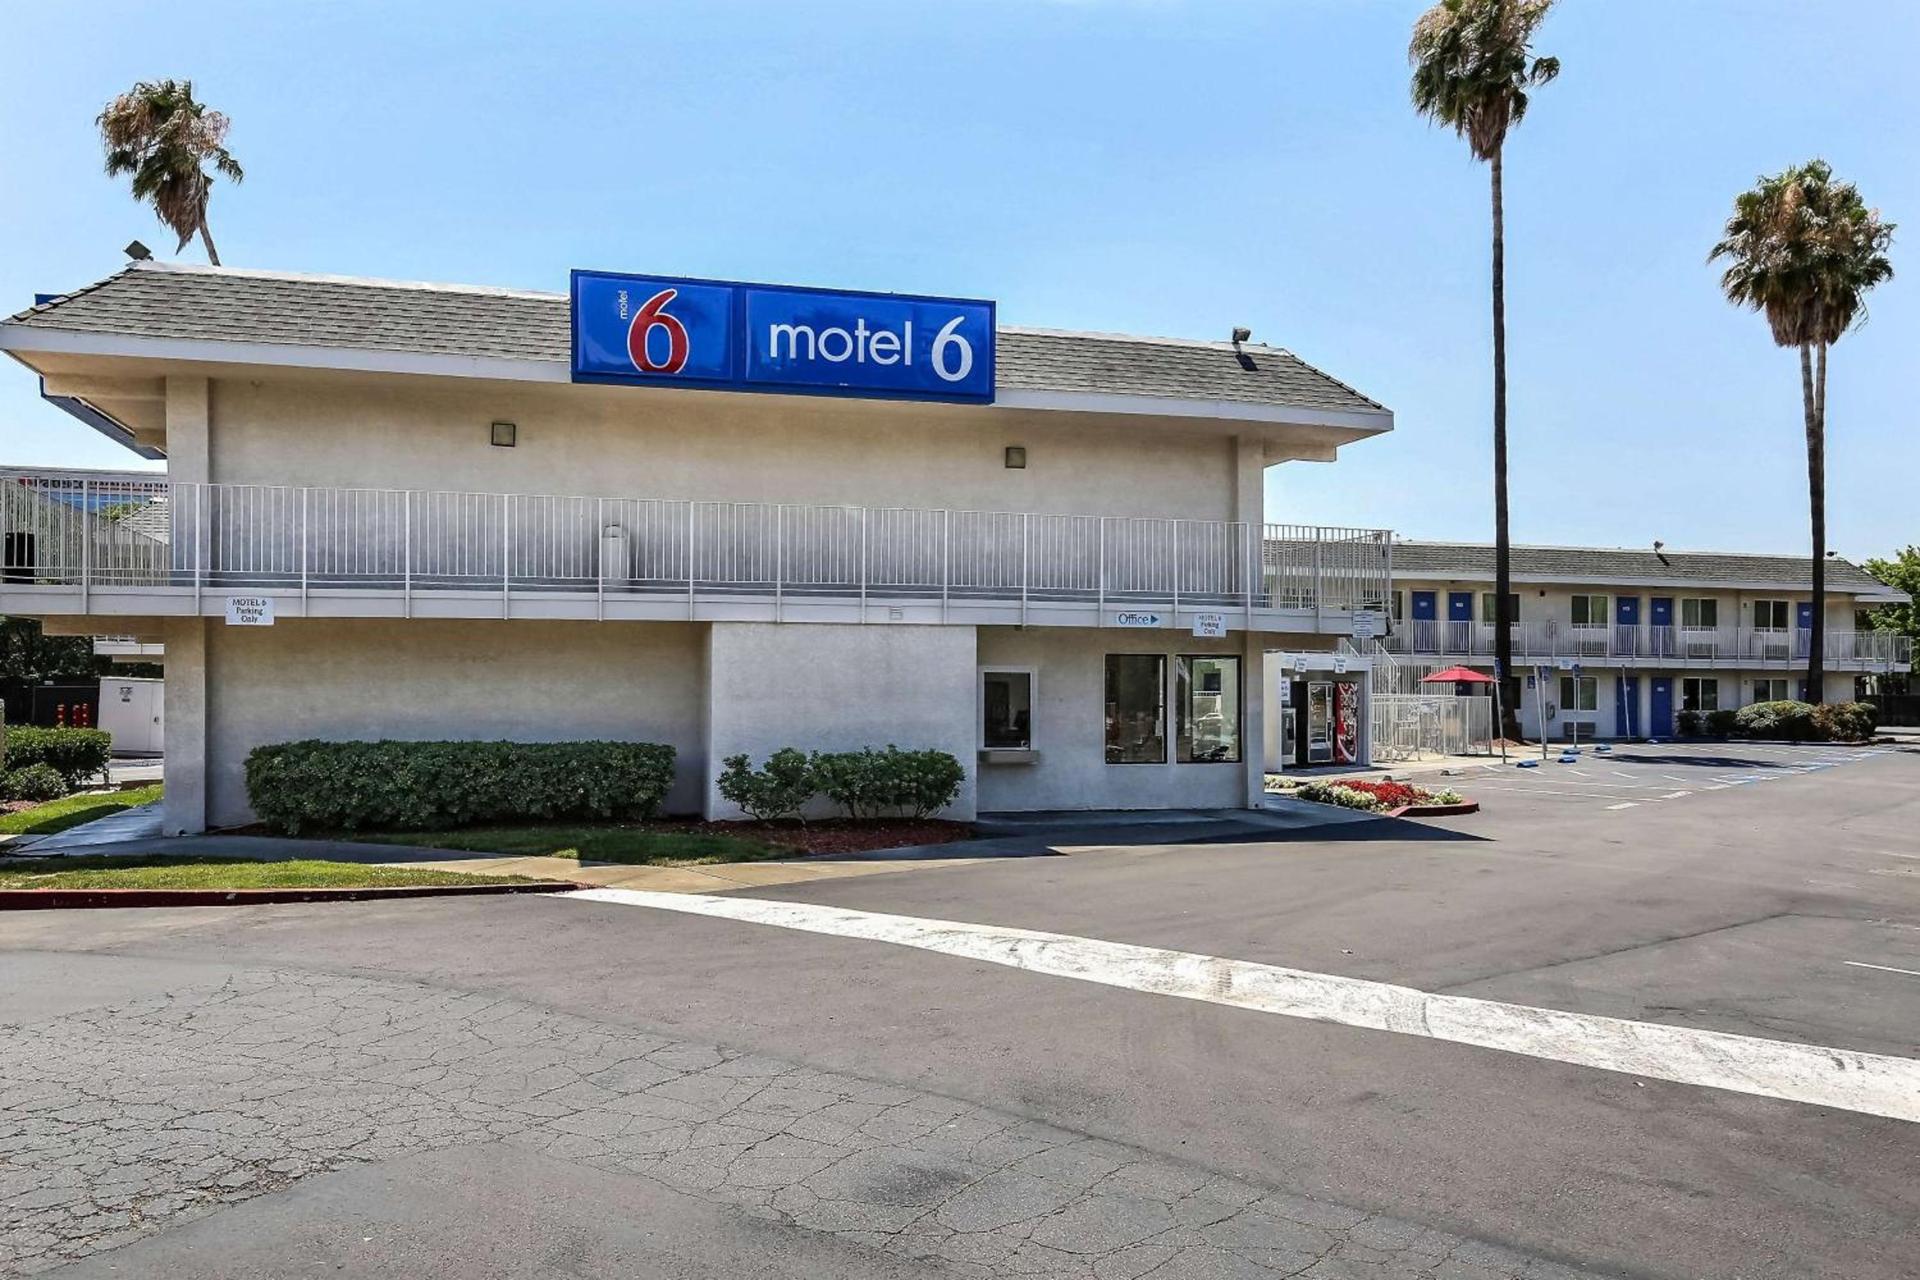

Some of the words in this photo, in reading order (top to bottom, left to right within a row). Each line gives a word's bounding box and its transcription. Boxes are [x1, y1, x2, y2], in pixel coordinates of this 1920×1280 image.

[618, 290, 628, 320] motel
[627, 288, 690, 374] 6
[769, 318, 912, 366] motel
[931, 315, 973, 382] 6
[232, 598, 260, 606] MOTEL
[236, 607, 263, 616] Parking
[241, 615, 258, 623] Only
[1118, 613, 1149, 625] Office
